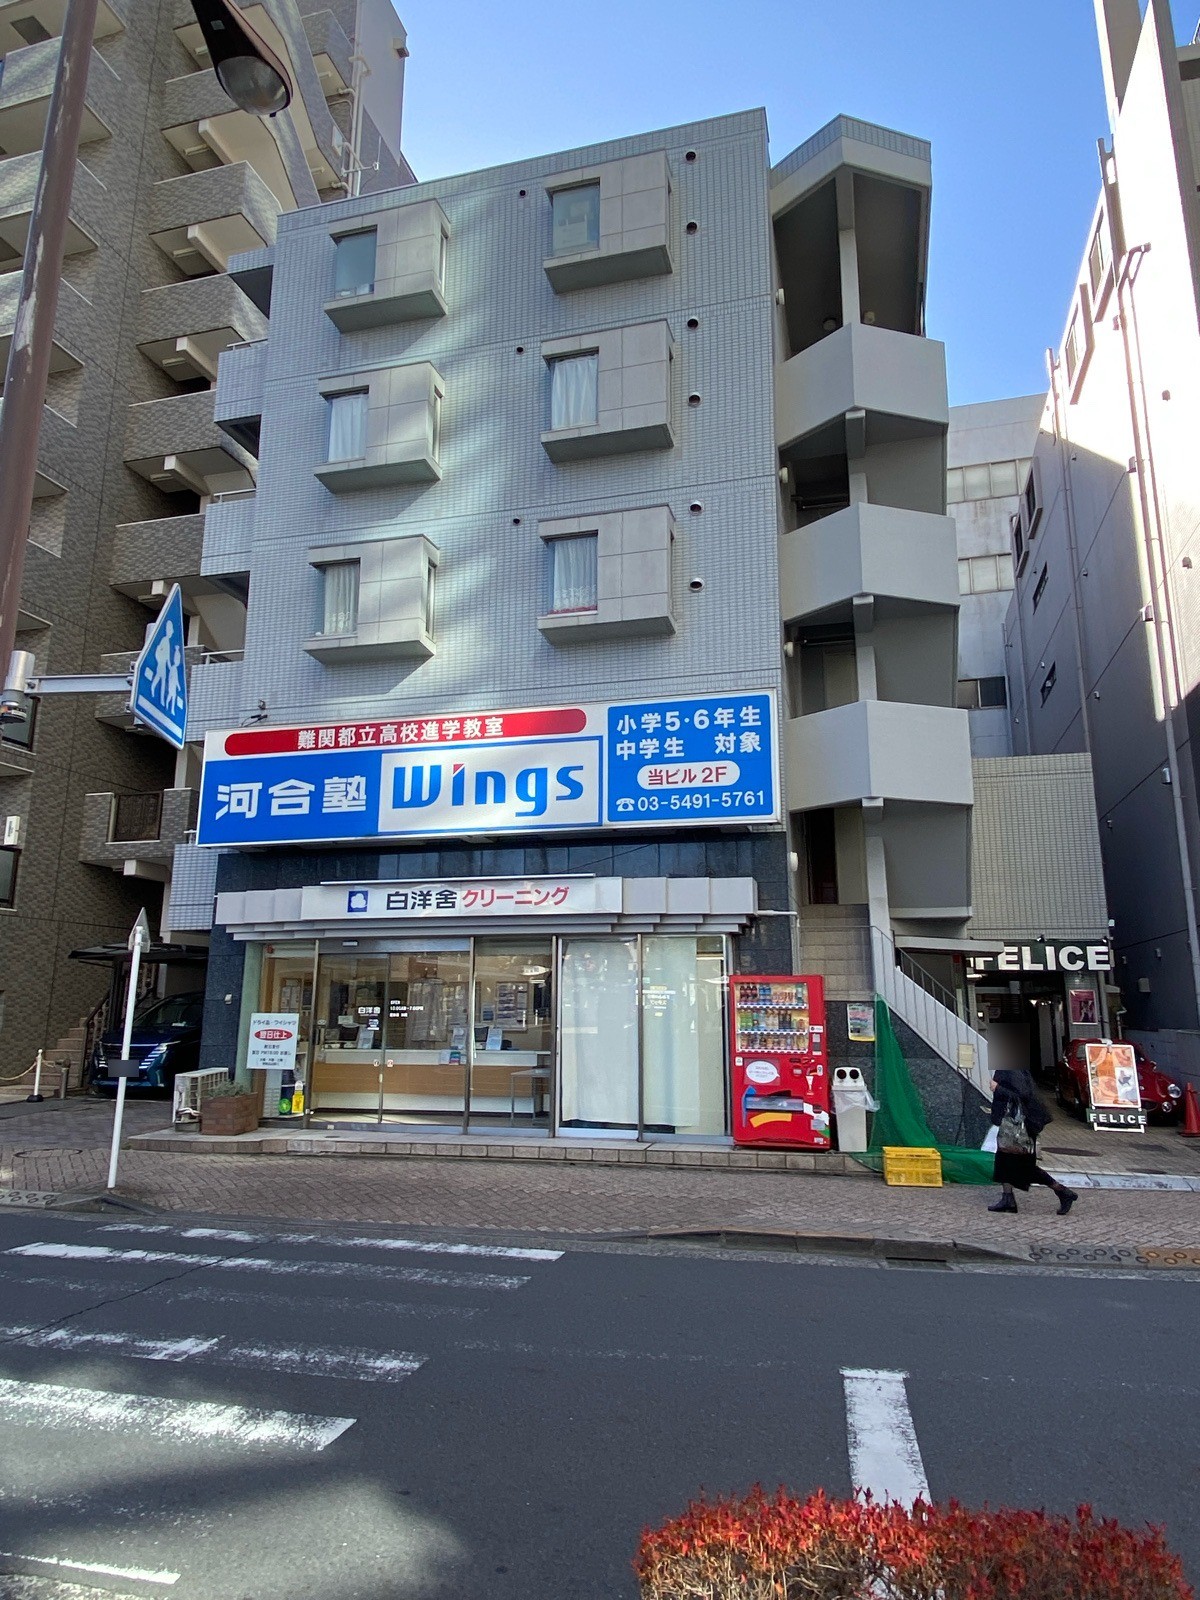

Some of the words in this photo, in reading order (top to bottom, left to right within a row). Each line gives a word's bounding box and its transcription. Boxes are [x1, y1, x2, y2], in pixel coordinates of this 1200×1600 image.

[297, 716, 504, 750] 難関都立高校進学教室
[616, 705, 762, 735] 小学5・6年生
[615, 736, 685, 760] 中学生
[714, 731, 762, 754] 対象
[215, 775, 367, 821] 河合塾
[392, 763, 584, 817] Wings
[637, 790, 765, 811] 03-5491-5761
[1089, 1113, 1147, 1125] FELICE
